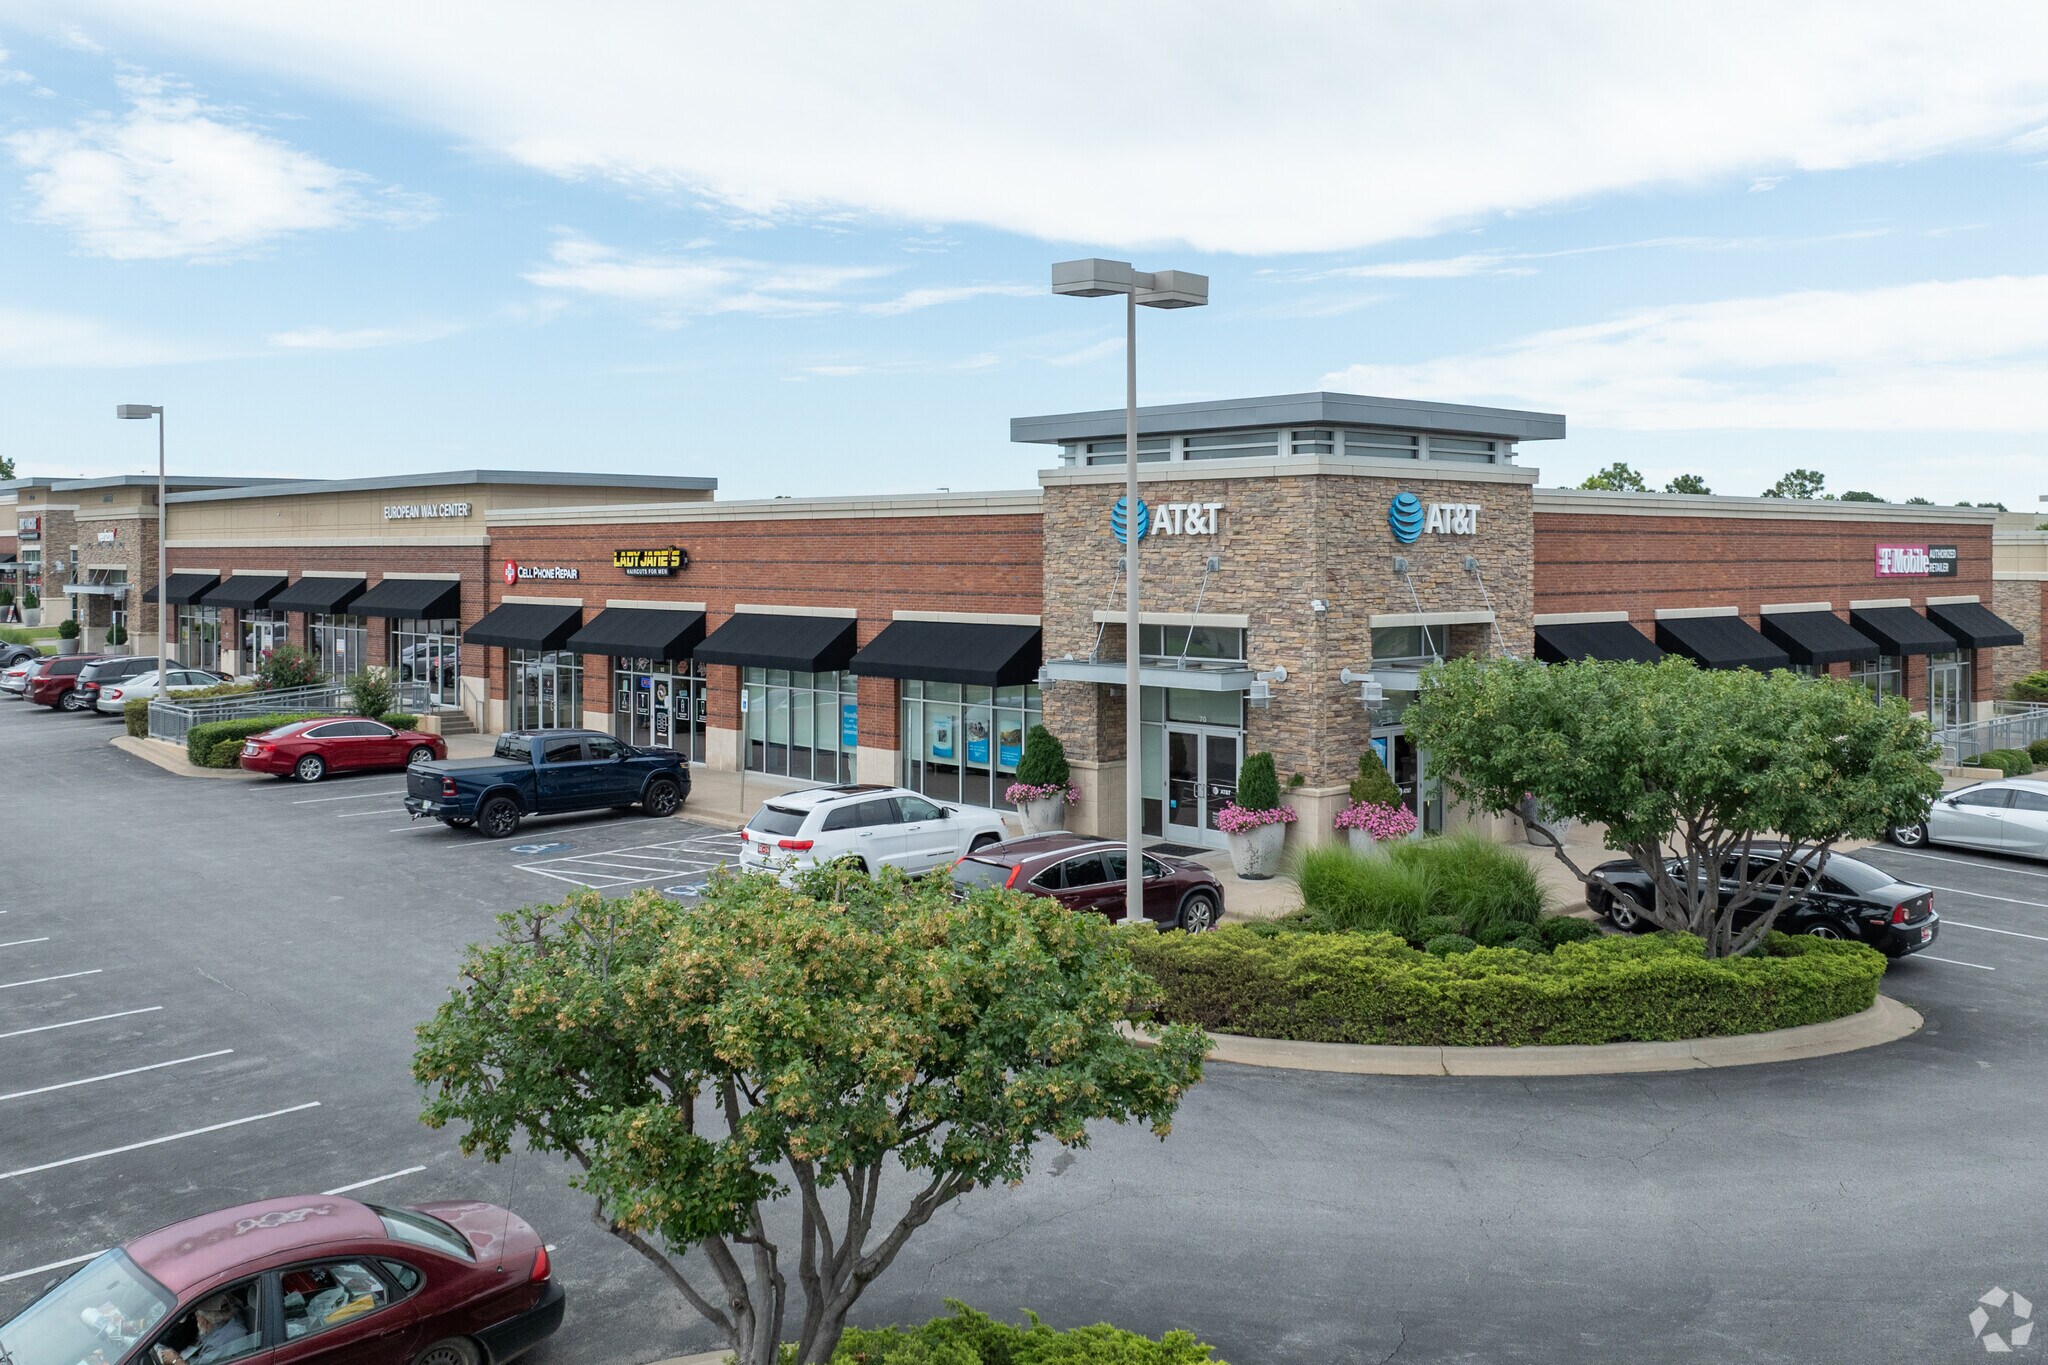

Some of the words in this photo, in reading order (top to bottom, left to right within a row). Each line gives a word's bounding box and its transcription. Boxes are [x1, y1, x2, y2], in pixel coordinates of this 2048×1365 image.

[384, 505, 420, 519] EUROPEAN
[421, 504, 438, 517] WAX
[439, 503, 471, 517] CENTER
[1424, 503, 1481, 535] AT&T
[1151, 503, 1224, 536] AT&T
[613, 551, 641, 567] LADY
[1929, 549, 1957, 559] AUTHORIZED
[1928, 562, 1949, 573] RETAILER
